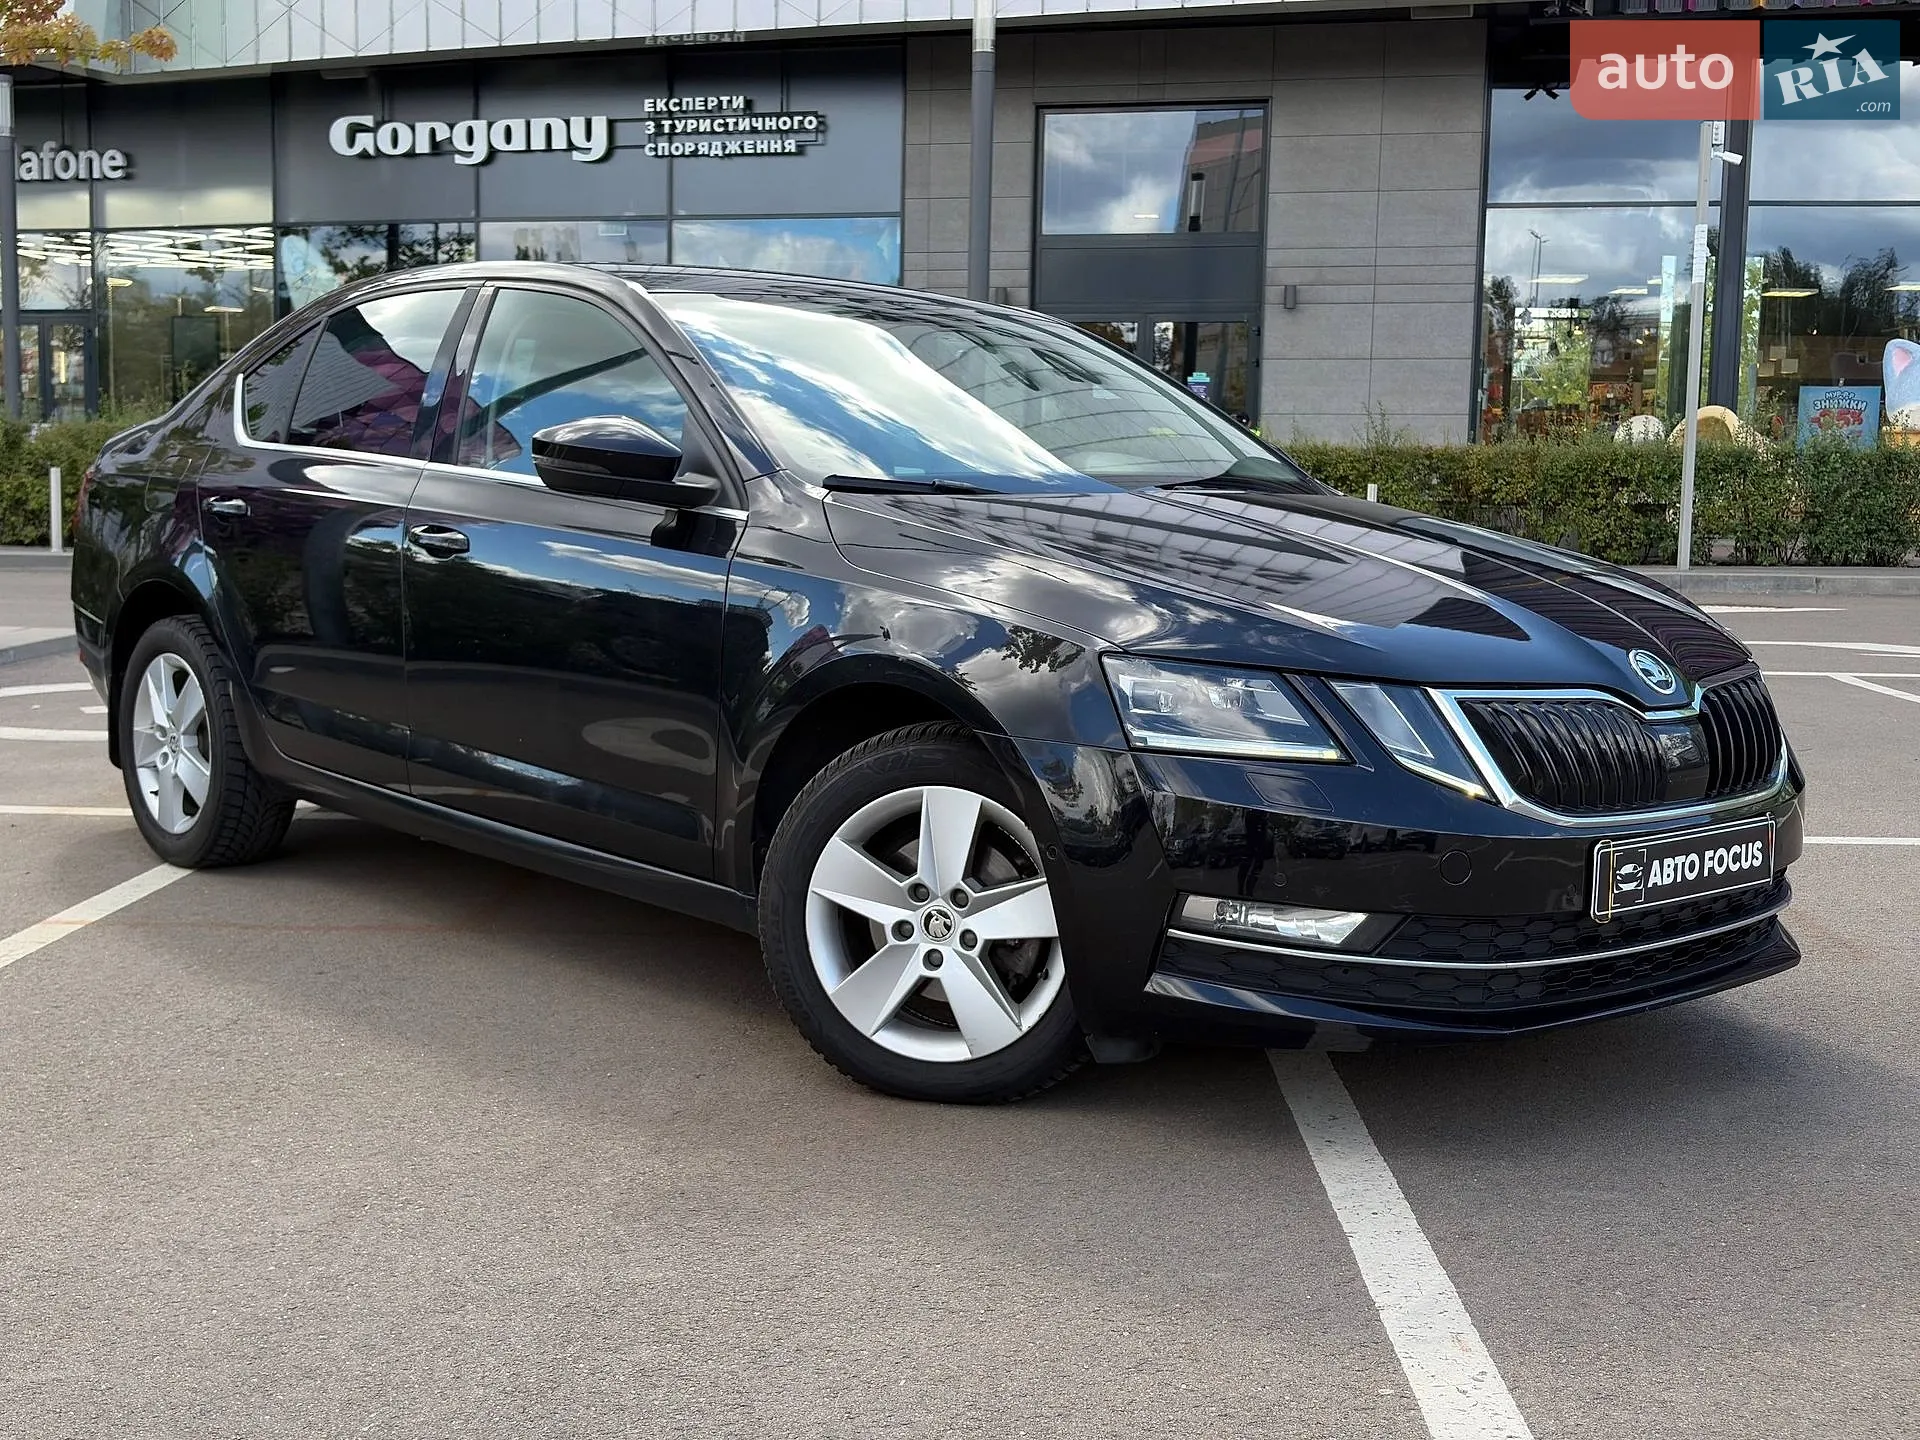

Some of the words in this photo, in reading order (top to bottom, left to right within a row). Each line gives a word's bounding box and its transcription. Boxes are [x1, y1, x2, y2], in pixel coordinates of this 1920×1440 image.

[644, 96, 744, 112] ЕКСПЕРТИ
[661, 116, 817, 133] ТУРИСТИЧНОГО
[329, 115, 607, 165] Gorgany
[644, 139, 796, 156] СПОРЯДЖЕННЯ
[14, 141, 127, 180] afone
[1814, 400, 1867, 410] ЗНИЖКИ
[1703, 840, 1763, 877] FOCUS
